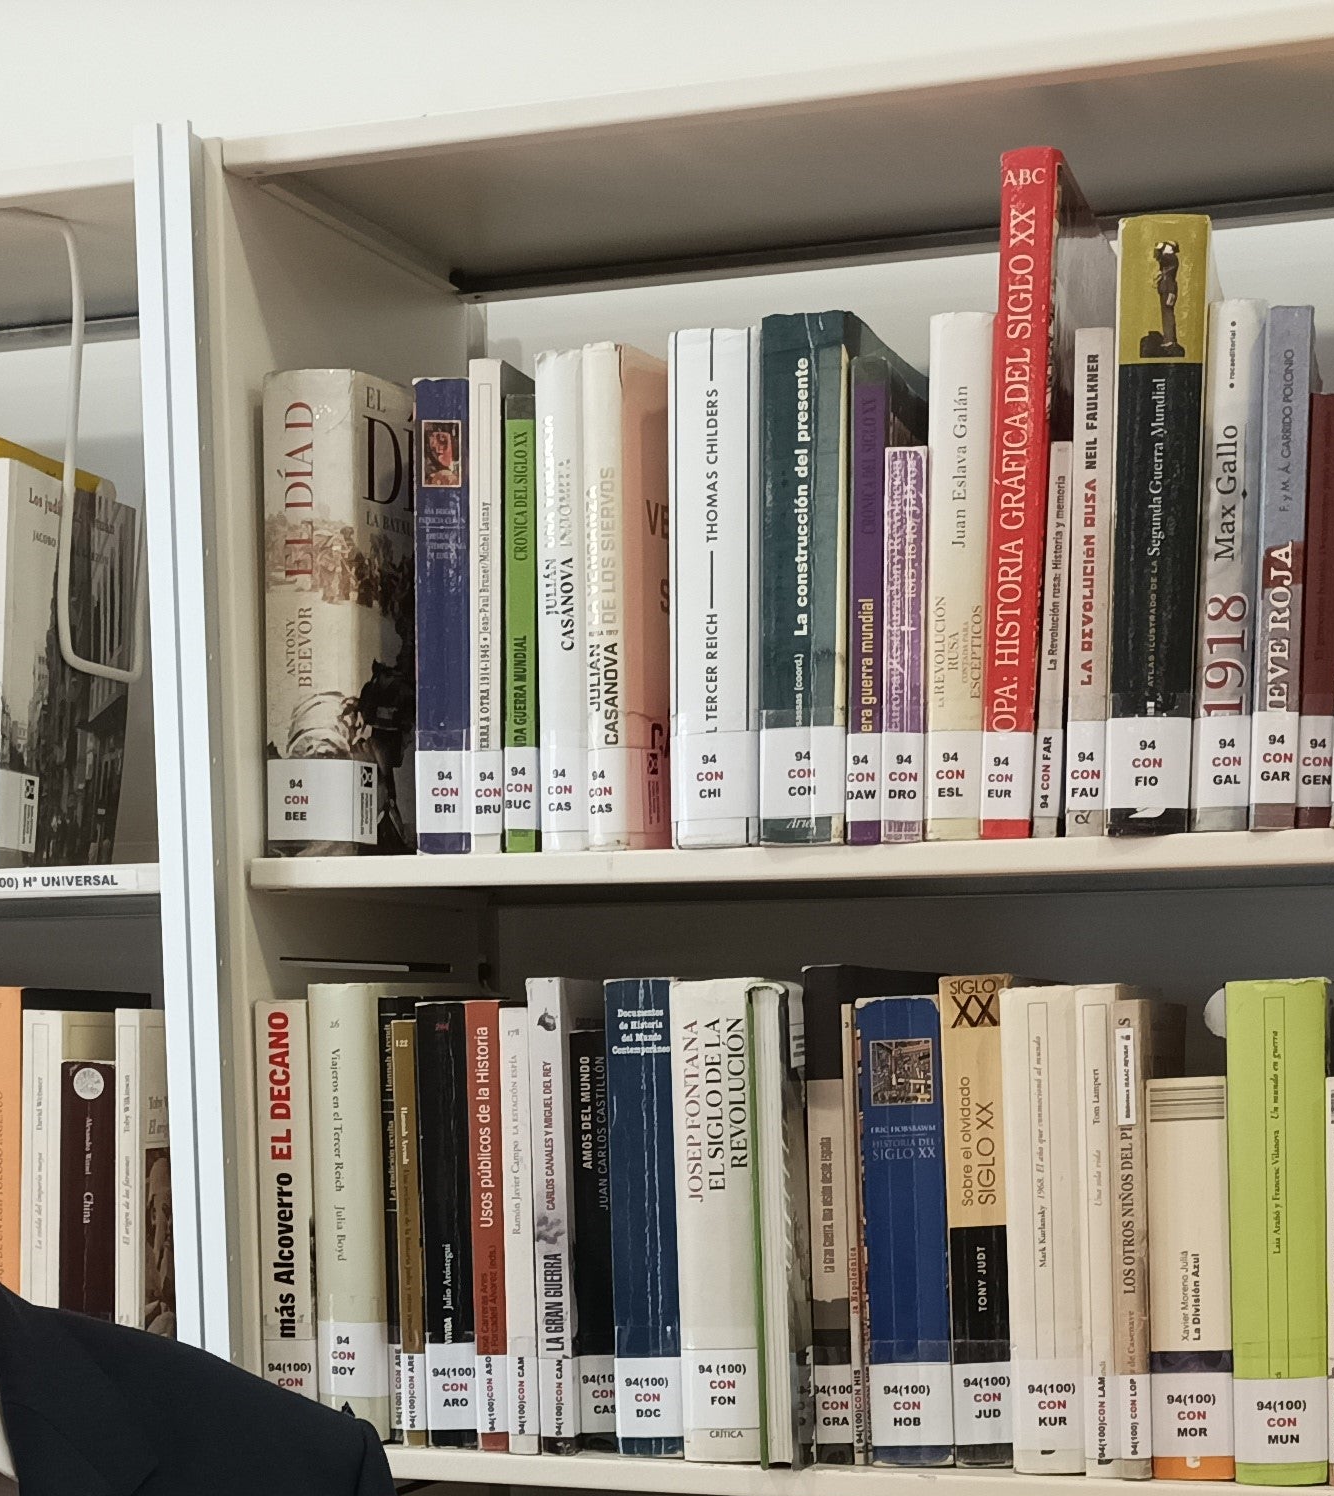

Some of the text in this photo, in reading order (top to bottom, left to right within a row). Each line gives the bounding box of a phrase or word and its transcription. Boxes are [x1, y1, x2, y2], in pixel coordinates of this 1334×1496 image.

[1003, 168, 1046, 185] ABC
[994, 206, 1036, 667] HISTORIA GRÁFICA DEL SIGLO XX
[278, 402, 314, 580] EL DÍA D
[794, 357, 810, 636] La construcción del presente
[1214, 424, 1240, 562] Max Gallo
[705, 388, 718, 721] TERCER REICH THOMAS CHILDERS
[287, 618, 295, 675] ANTONY
[299, 606, 312, 687] BEEVOR
[1206, 590, 1247, 716] 1918
[284, 796, 309, 805] CON
[285, 811, 307, 821] BEE
[289, 779, 303, 788] 94
[41, 875, 118, 887] UNIVERSAL
[949, 979, 996, 994] SIGLO
[951, 996, 998, 1028] XX
[683, 1019, 703, 1203] JOSEP FONTANA
[704, 1018, 726, 1192] EL SIGLO DE LA
[722, 1017, 748, 1169] REVOLUCIÓN
[267, 1011, 295, 1338] más Alcoverro EL DECANO
[976, 1245, 988, 1313] TONY JUDT
